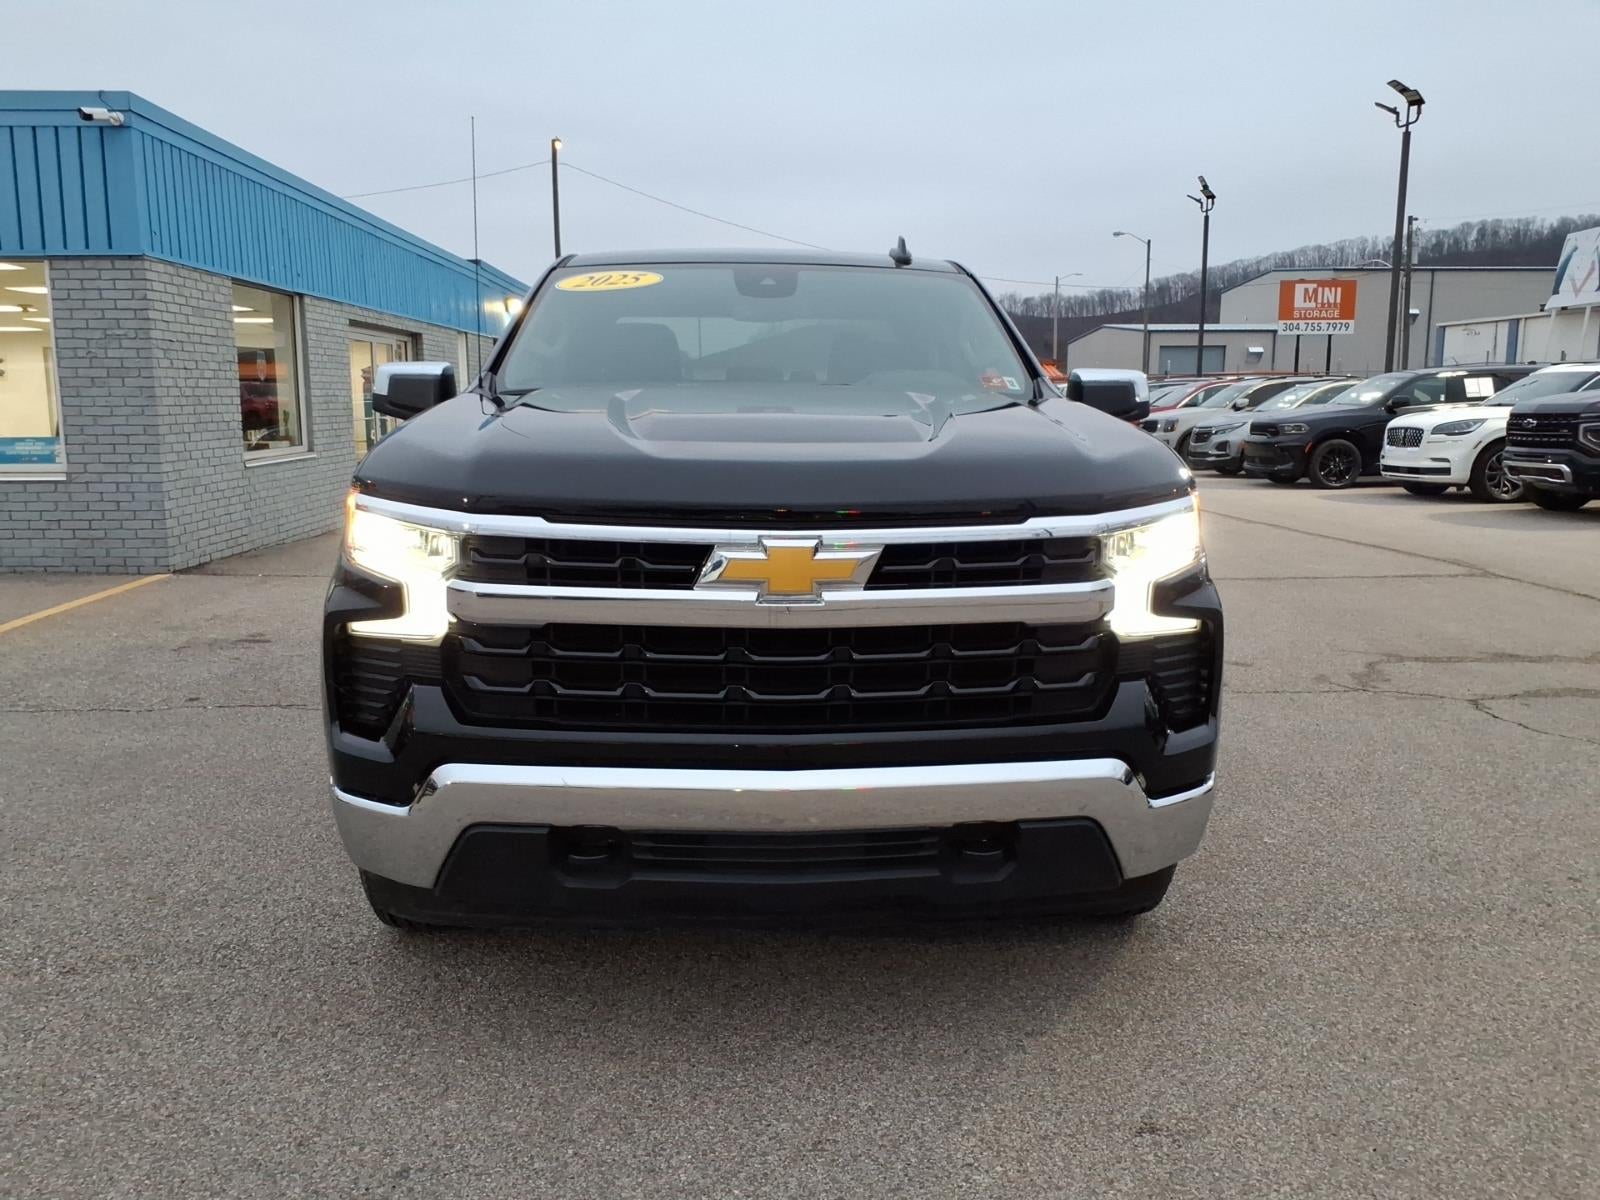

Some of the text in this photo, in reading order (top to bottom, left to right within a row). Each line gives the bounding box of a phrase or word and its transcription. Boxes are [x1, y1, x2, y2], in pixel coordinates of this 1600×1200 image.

[572, 273, 648, 288] 2025
[1299, 285, 1342, 305] MINI
[1293, 310, 1340, 319] STORAGE
[1282, 322, 1350, 332] 304.755.7979
